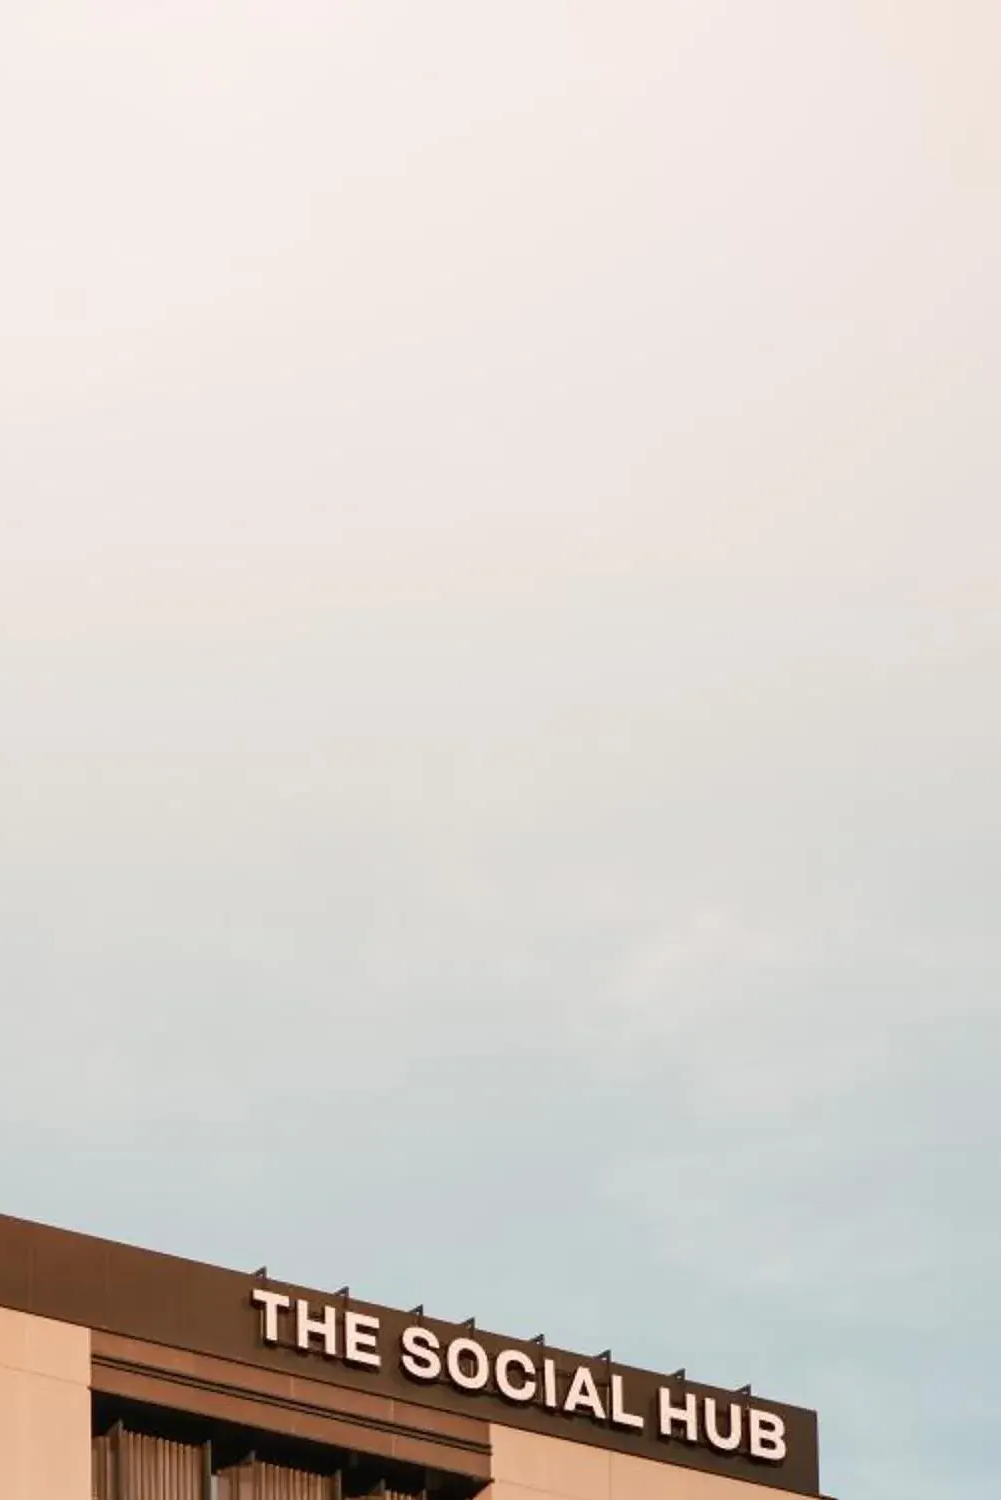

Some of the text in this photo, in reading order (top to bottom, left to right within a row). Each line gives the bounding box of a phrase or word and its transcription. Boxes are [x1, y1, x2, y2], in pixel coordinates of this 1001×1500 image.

[252, 1288, 789, 1461] THE SOCIAL HUB
